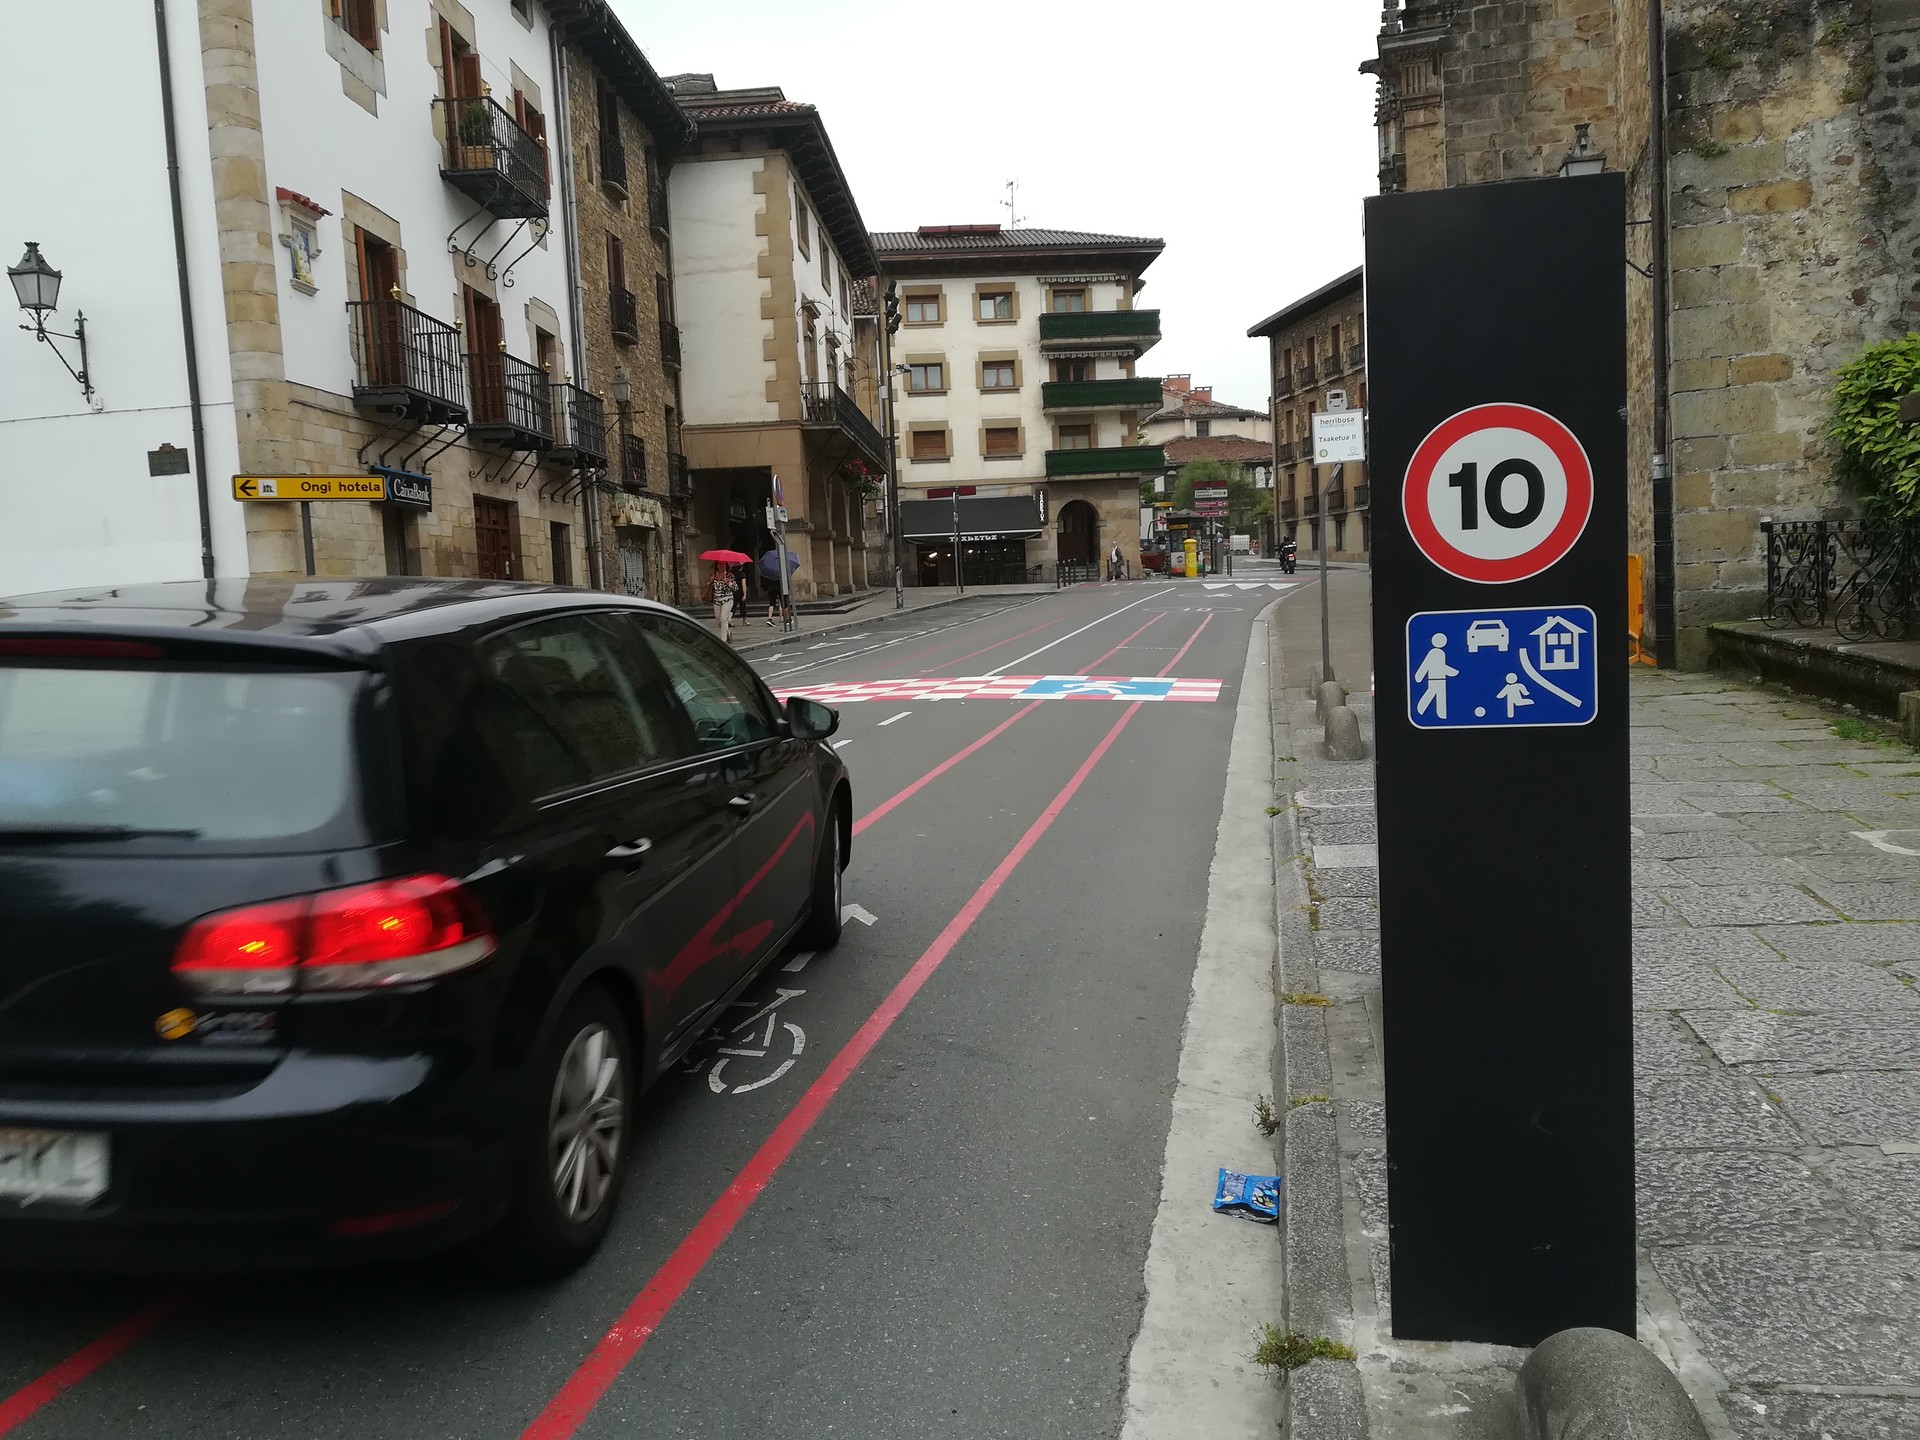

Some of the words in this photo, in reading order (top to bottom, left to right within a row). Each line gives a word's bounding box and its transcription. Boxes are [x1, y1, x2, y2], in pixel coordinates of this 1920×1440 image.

[1320, 417, 1355, 425] herribusa
[301, 481, 331, 494] Ongi
[338, 481, 381, 492] hotela
[394, 478, 430, 501] CaixaBank
[1449, 458, 1545, 531] 10
